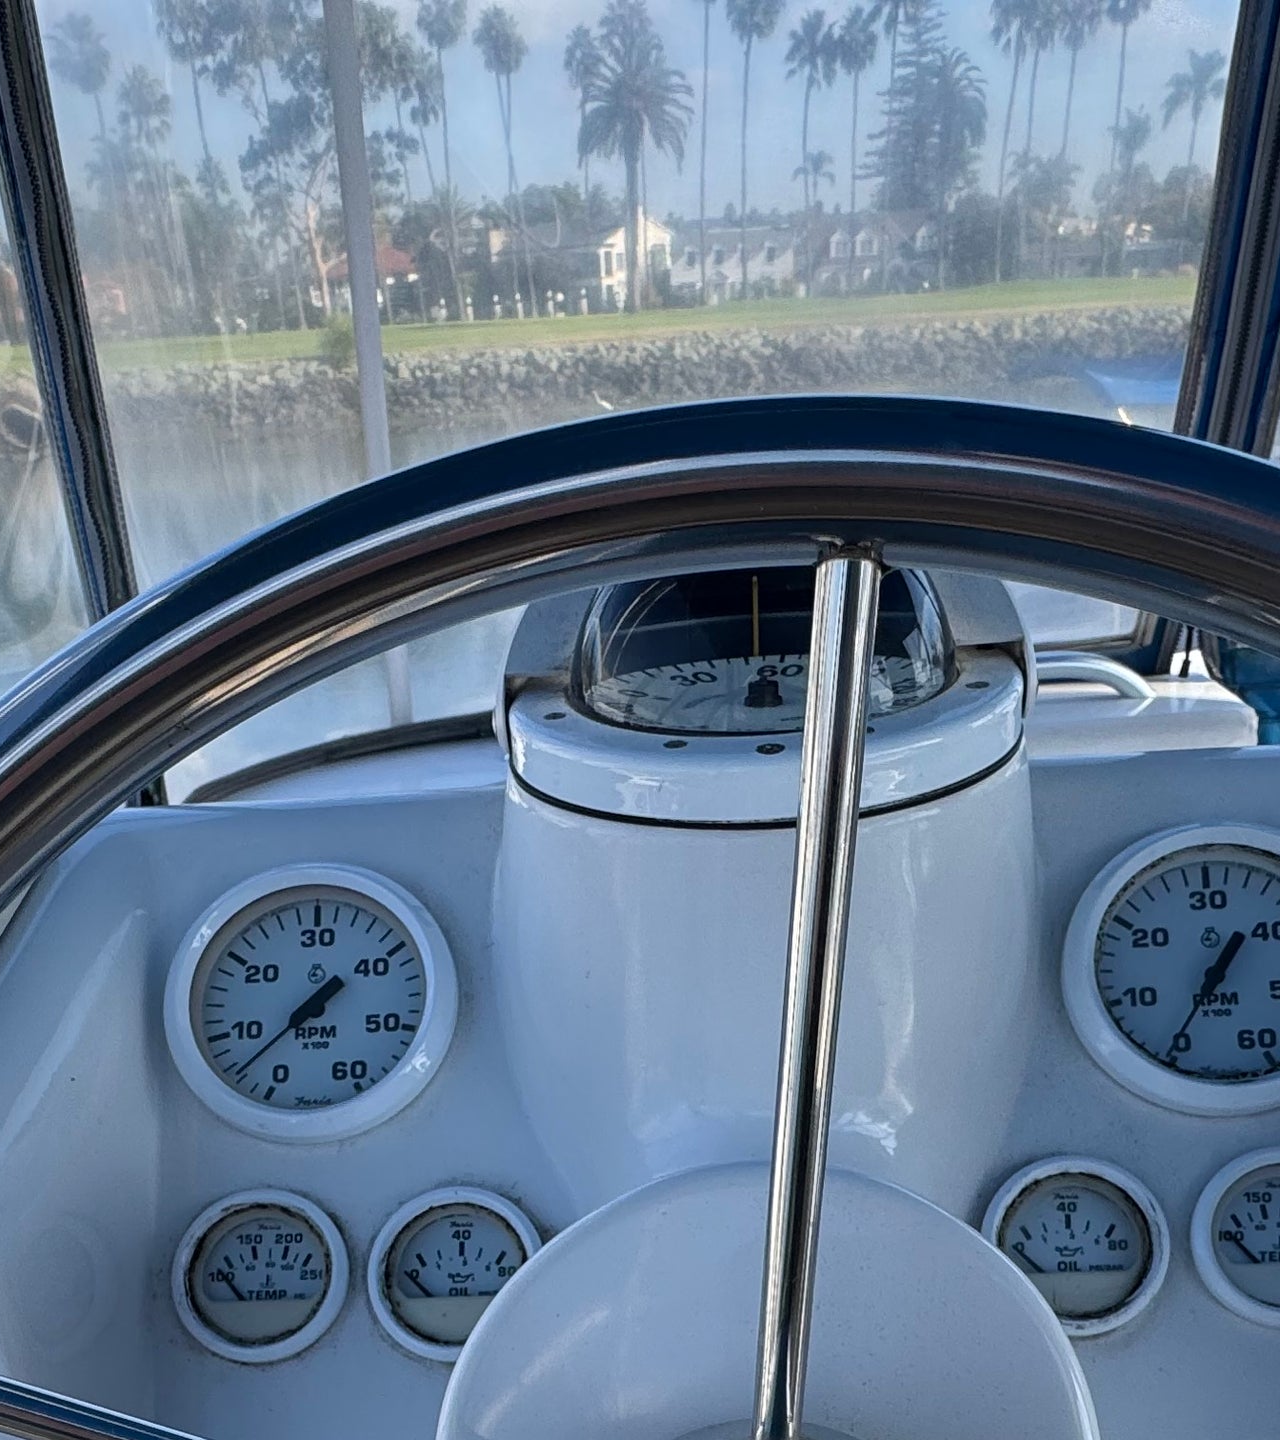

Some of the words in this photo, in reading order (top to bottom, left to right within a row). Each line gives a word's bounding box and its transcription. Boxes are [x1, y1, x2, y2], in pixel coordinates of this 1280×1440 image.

[756, 664, 804, 678] 60
[669, 671, 718, 688] 30
[1188, 890, 1228, 911] 30
[300, 928, 336, 948] 30
[1131, 927, 1170, 949] 20
[244, 964, 280, 984] 20
[353, 957, 390, 977] 40
[1122, 987, 1158, 1008] 10
[1192, 991, 1240, 1007] RPM
[230, 1020, 264, 1040] 10
[365, 1012, 400, 1033] 50
[294, 1024, 337, 1040] RPM
[1236, 1027, 1277, 1050] 60
[1172, 1031, 1192, 1053] 0
[271, 1064, 290, 1084] 0
[331, 1059, 368, 1081] 60
[1243, 1191, 1272, 1204] 150
[1056, 1201, 1078, 1213] 40
[236, 1233, 263, 1245] 150
[274, 1232, 304, 1245] 200
[451, 1229, 472, 1241] 40
[1218, 1230, 1245, 1242] 100
[1107, 1239, 1129, 1252] 80
[1057, 1260, 1081, 1273] OIL
[208, 1271, 236, 1283] 100
[247, 1289, 288, 1301] TEMP
[448, 1286, 470, 1297] OIL
